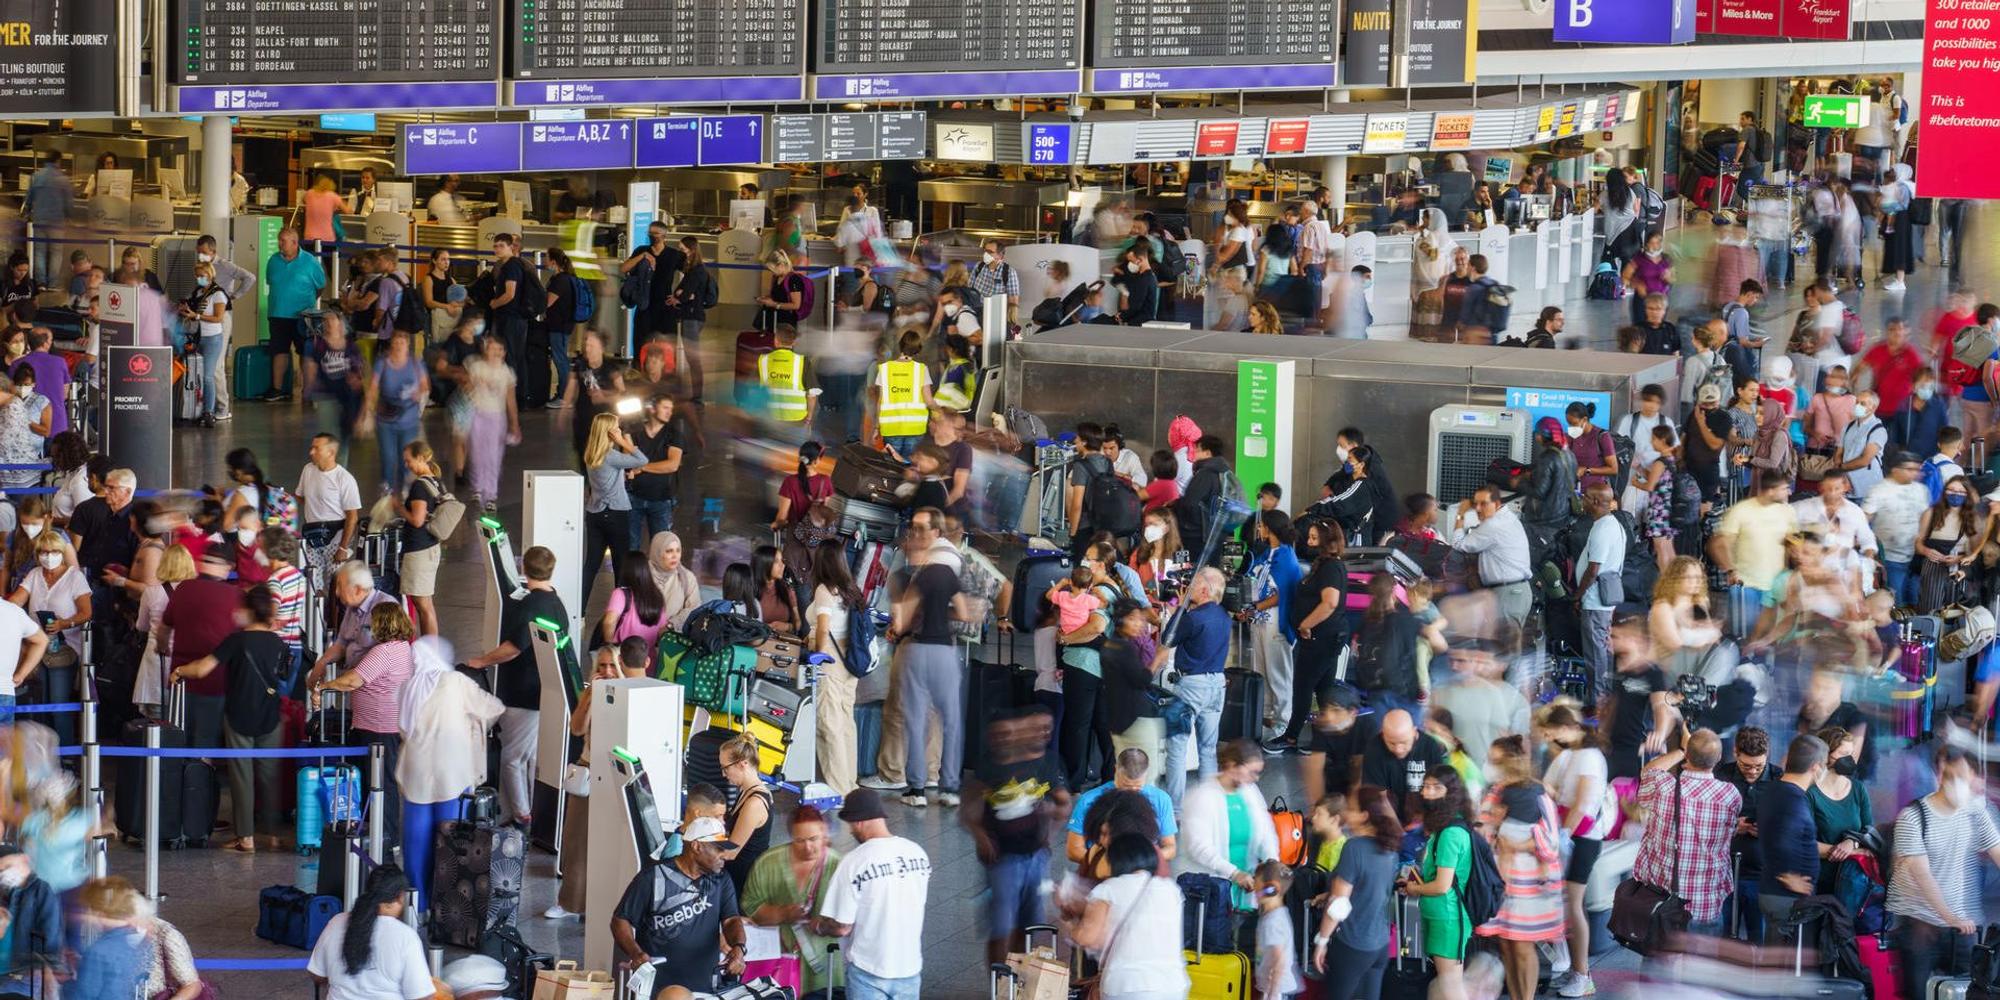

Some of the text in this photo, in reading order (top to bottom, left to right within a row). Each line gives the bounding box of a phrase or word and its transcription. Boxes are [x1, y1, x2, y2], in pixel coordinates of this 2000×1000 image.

[206, 1, 486, 11] LH 3684 GOETTINGEN-KASSEL T4
[557, 0, 575, 9] 2050
[584, 0, 624, 9] ANCHORAGE
[1936, 0, 1958, 10] 300
[584, 12, 615, 20] DETROIT
[784, 10, 792, 18] E5
[840, 10, 848, 18] A3
[1569, 0, 1592, 27] B
[1722, 9, 1773, 20] Miles & More
[1813, 9, 1840, 17] Frankfurt
[840, 20, 848, 28] LH
[1152, 16, 1182, 24] HURGHADA
[1413, 20, 1426, 30] FOR
[1436, 20, 1462, 30] JOURNEY
[1812, 16, 1833, 24] Airport
[1935, 18, 1990, 30] and 1000
[206, 24, 490, 35] LH 334 NEAPEL 263-461 A20
[538, 24, 548, 32] LH
[562, 24, 574, 32] 442
[584, 23, 615, 32] DETROIT
[1152, 26, 1200, 35] SAN FRANCISCO
[34, 34, 51, 46] FOR
[51, 34, 69, 46] THE
[70, 34, 108, 46] JOURNEY
[538, 35, 548, 43] LH
[558, 35, 574, 43] 1152
[584, 34, 606, 43] PALMA
[624, 34, 659, 42] MALLORCA
[744, 34, 774, 42] 263-461
[840, 31, 848, 40] LH
[880, 30, 896, 39] PORT
[206, 38, 216, 48] LH
[230, 38, 246, 47] 438
[256, 38, 310, 47] DALLAS-FORT
[314, 38, 339, 46] WORTH
[434, 37, 466, 45] 263-461
[860, 42, 912, 50] 302 BUKAREST
[1152, 37, 1178, 45] ATLANTA
[1933, 38, 1997, 51] possibilities
[206, 50, 216, 59] LH
[230, 50, 245, 59] 582
[256, 50, 280, 59] KAIRO
[434, 48, 466, 57] 263-461
[538, 46, 548, 55] LH
[556, 46, 574, 55] 3714
[1152, 47, 1189, 56] BIRMINGHAM
[538, 54, 790, 67] LH 3534 AACHEN HBF-KOELN HBF T7
[860, 54, 872, 62] 062
[26, 63, 65, 74] BOUTIQUE
[206, 60, 489, 71] LH 898 BORDEAUX 263-461 A17
[1932, 57, 1956, 68] take
[1958, 59, 1980, 71] you
[248, 90, 268, 99] Abflug
[248, 100, 278, 108] Departures
[1931, 95, 1965, 107] This is
[667, 121, 722, 138] Terminal D,E
[1371, 122, 1405, 131] TICKETS
[438, 128, 477, 144] Abflug C
[548, 124, 610, 143] Abflug A,B,Z
[438, 138, 466, 146] Departures
[548, 135, 576, 143] Departures
[1034, 150, 1054, 160] 570
[770, 371, 791, 380] Crew
[1542, 393, 1566, 401] Covid-19
[653, 896, 712, 930] Reebok
